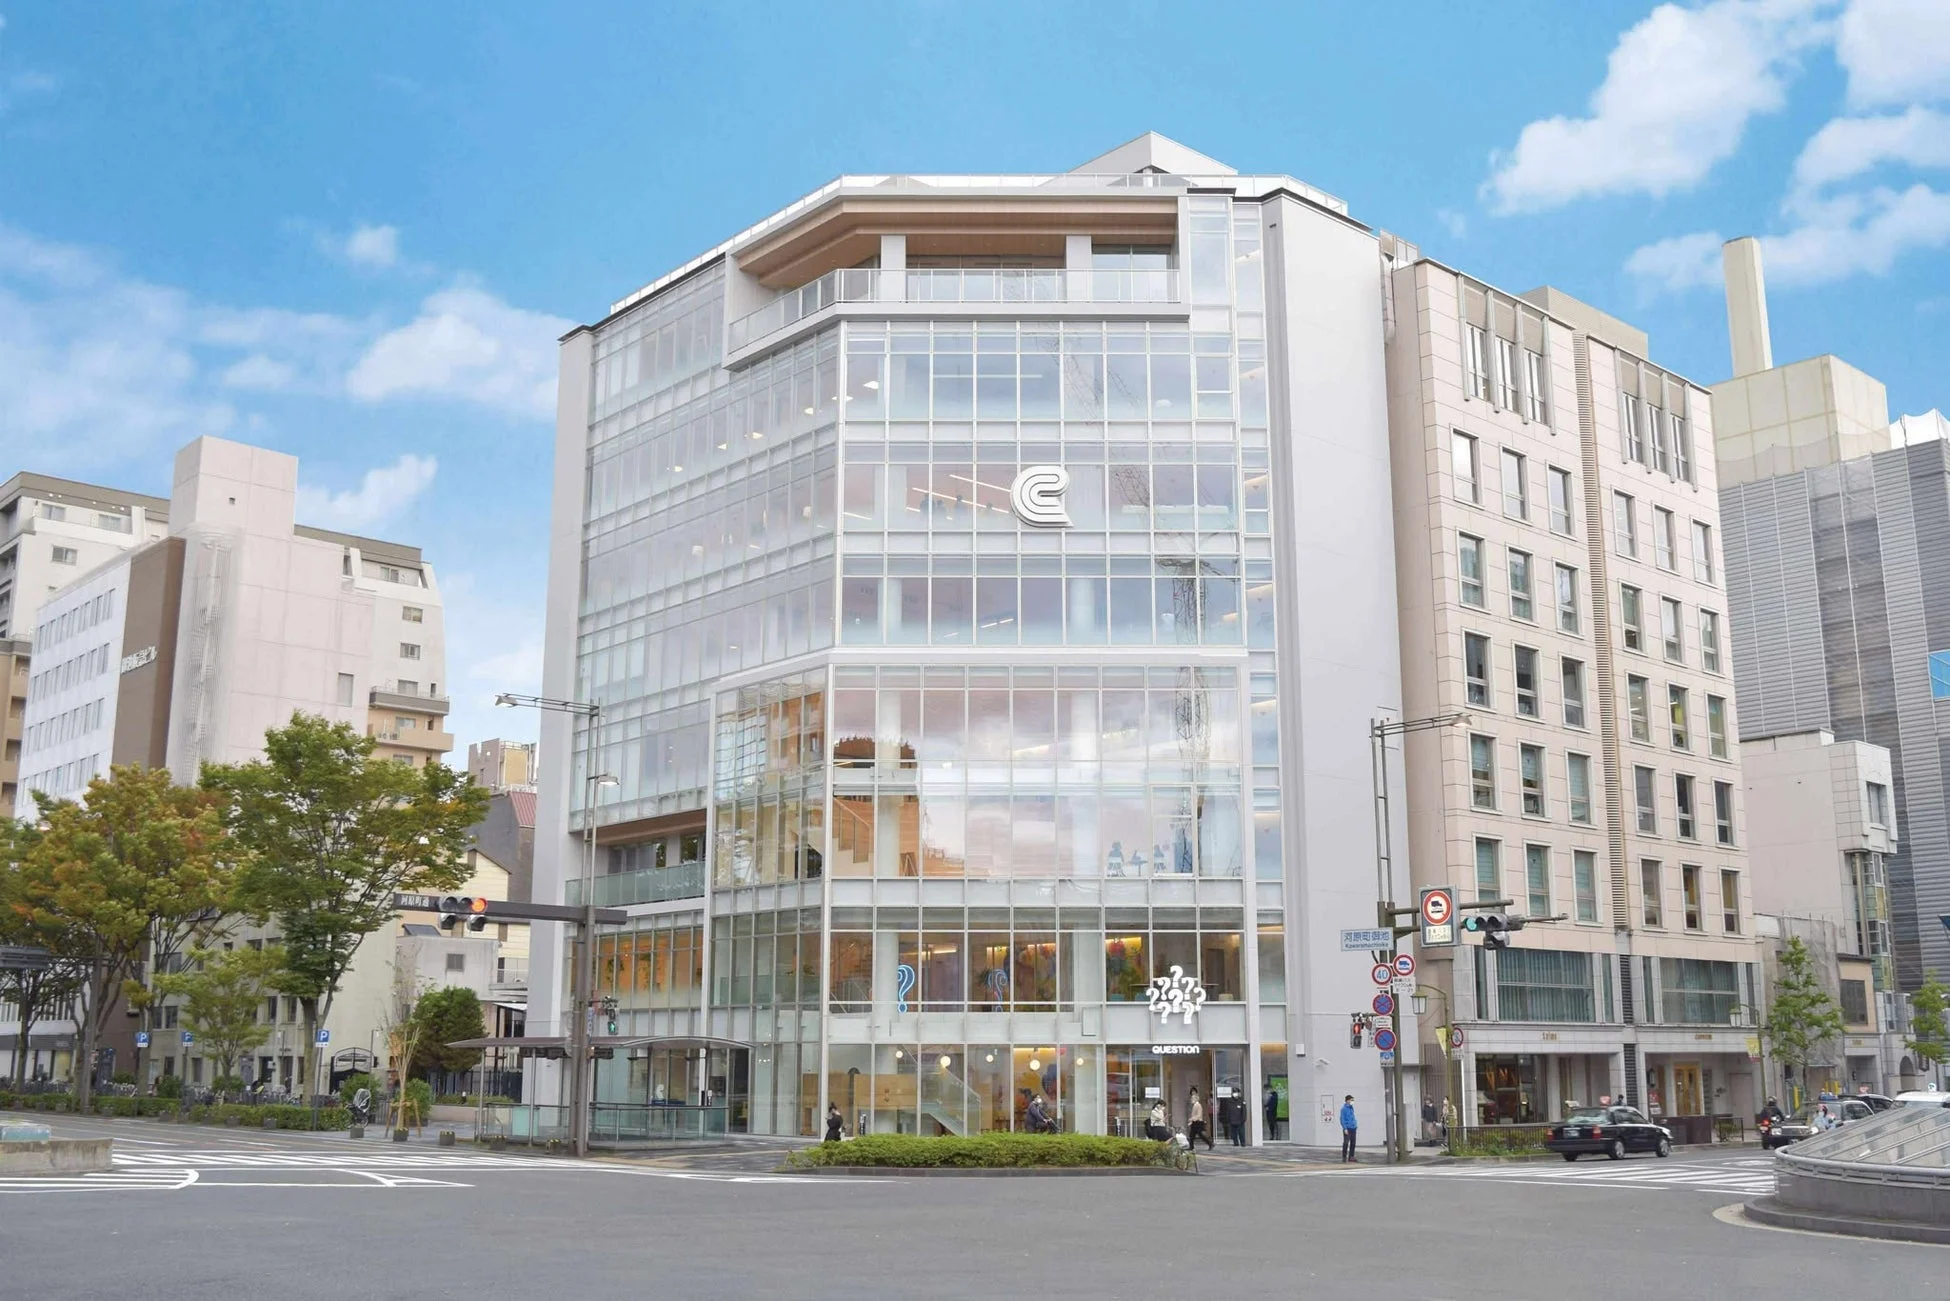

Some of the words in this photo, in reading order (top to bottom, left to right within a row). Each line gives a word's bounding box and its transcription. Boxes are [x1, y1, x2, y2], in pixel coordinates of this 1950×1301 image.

[1344, 931, 1390, 942] 河原町御池
[1377, 970, 1388, 980] 40
[140, 1033, 147, 1042] P
[320, 1031, 328, 1041] P
[1152, 1045, 1200, 1054] QUESTION
